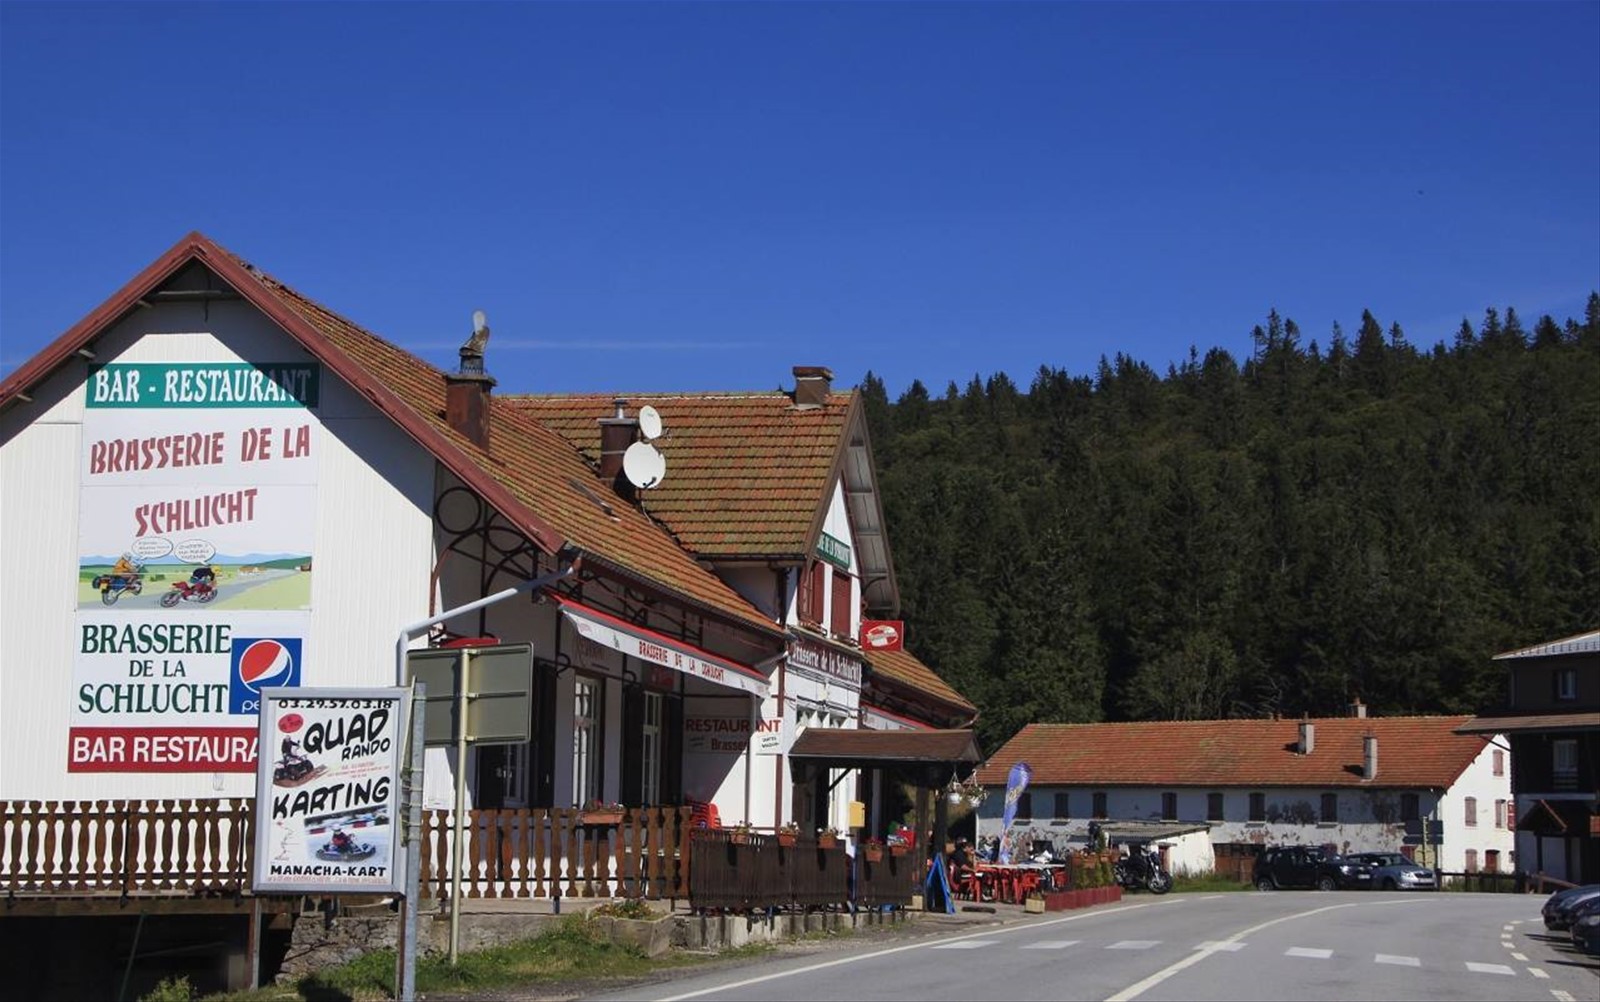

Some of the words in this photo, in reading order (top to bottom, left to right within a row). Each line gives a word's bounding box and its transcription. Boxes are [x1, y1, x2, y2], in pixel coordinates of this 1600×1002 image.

[94, 369, 140, 403] BAR
[164, 369, 311, 403] RESTAURANT
[90, 432, 224, 475] BRASSERIE
[241, 427, 272, 462] DE
[283, 424, 310, 459] LA
[135, 488, 258, 537] SCHLUCHT
[81, 623, 232, 654] BRASSERIE
[129, 659, 154, 678] DE
[163, 660, 187, 678] LA
[639, 640, 668, 663] BRASSERIE
[674, 653, 682, 668] DE
[78, 684, 228, 714] SCHLUCHT
[303, 708, 389, 755] QUAD
[72, 736, 128, 763] BAR
[341, 737, 391, 761] RANDO
[273, 776, 391, 820] KARTING
[270, 865, 387, 877] MANACHA-KART
